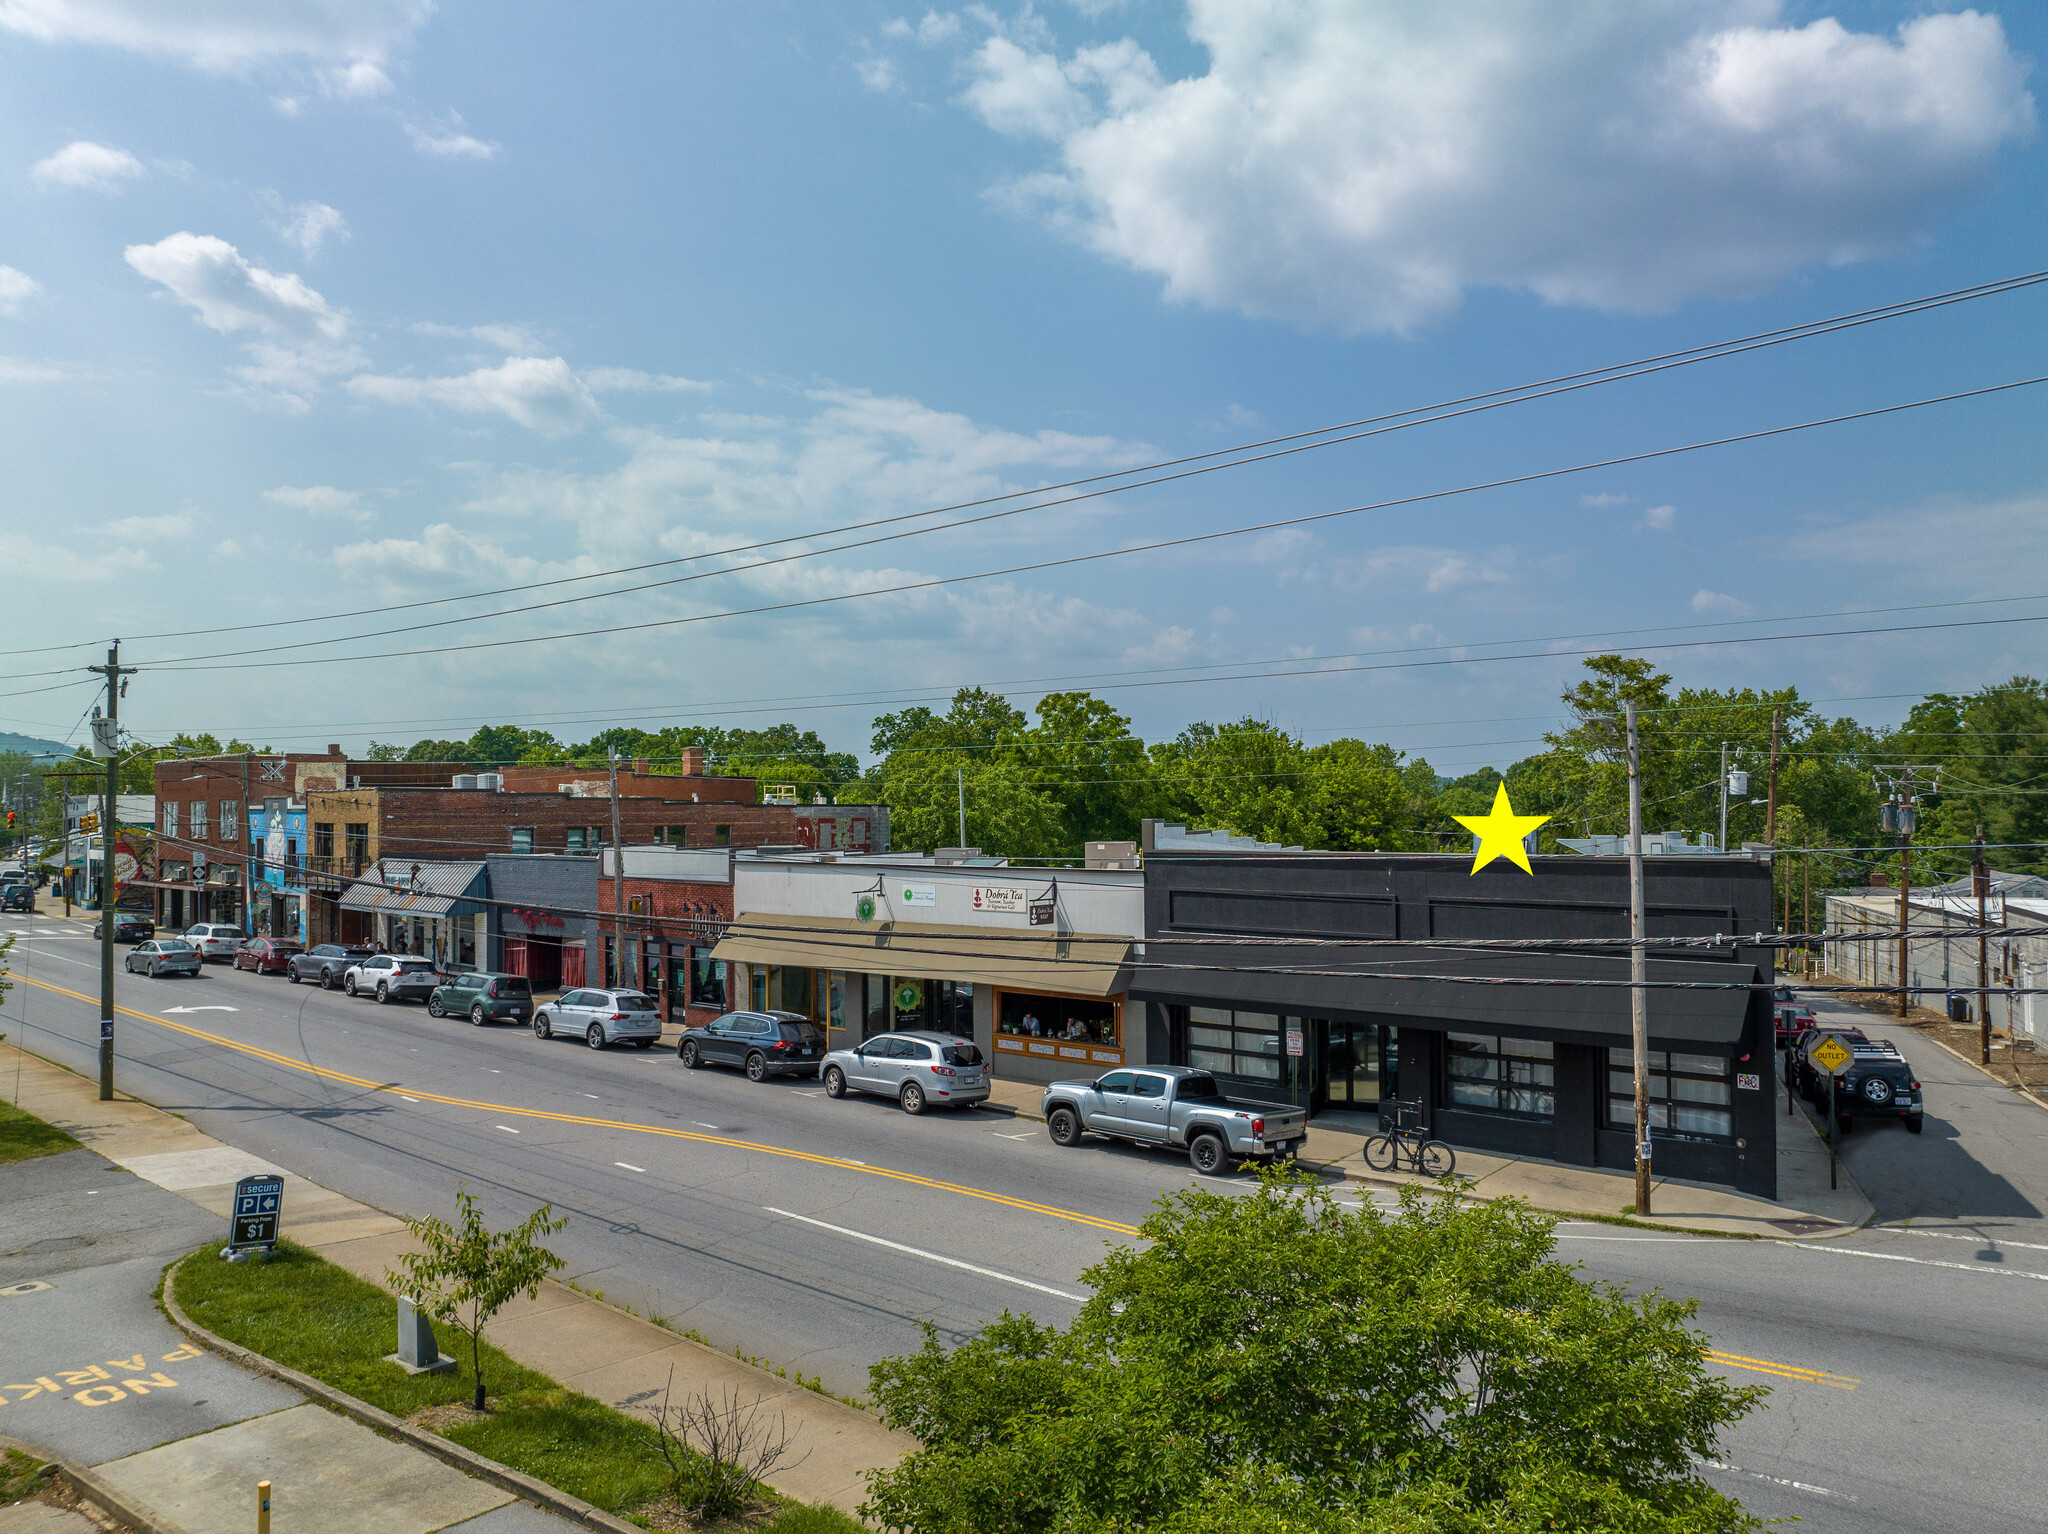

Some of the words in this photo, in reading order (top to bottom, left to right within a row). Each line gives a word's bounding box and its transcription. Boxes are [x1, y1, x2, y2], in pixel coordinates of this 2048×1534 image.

[985, 888, 1009, 899] Dobrá
[1010, 888, 1023, 900] Tea
[1817, 1052, 1845, 1060] OUTLET
[247, 1183, 279, 1194] secure
[242, 1198, 254, 1212] P
[247, 1223, 264, 1239] $1
[73, 1372, 179, 1406] NO
